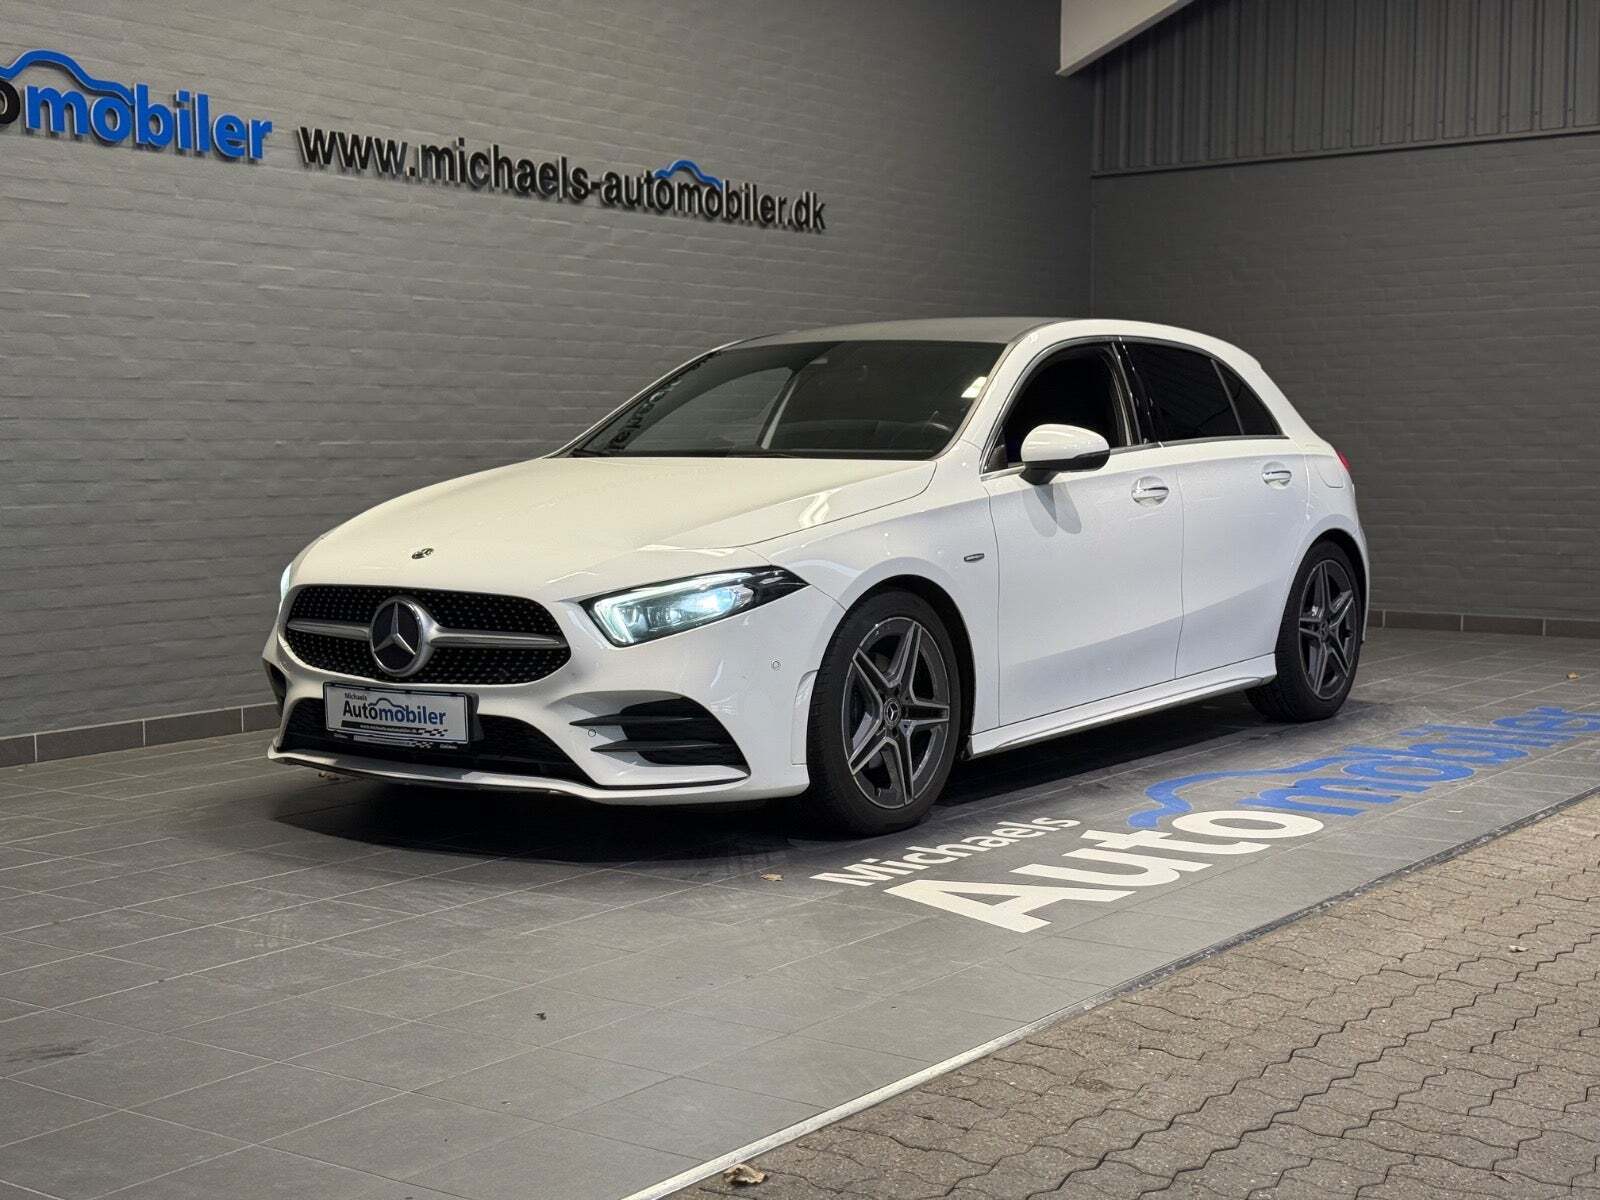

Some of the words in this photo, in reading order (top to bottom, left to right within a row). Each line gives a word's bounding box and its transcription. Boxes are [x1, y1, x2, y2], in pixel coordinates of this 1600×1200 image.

[297, 126, 827, 232] www.michaels-automobiler.dk
[343, 700, 447, 725] Automobiler
[809, 817, 1081, 887] Michaels
